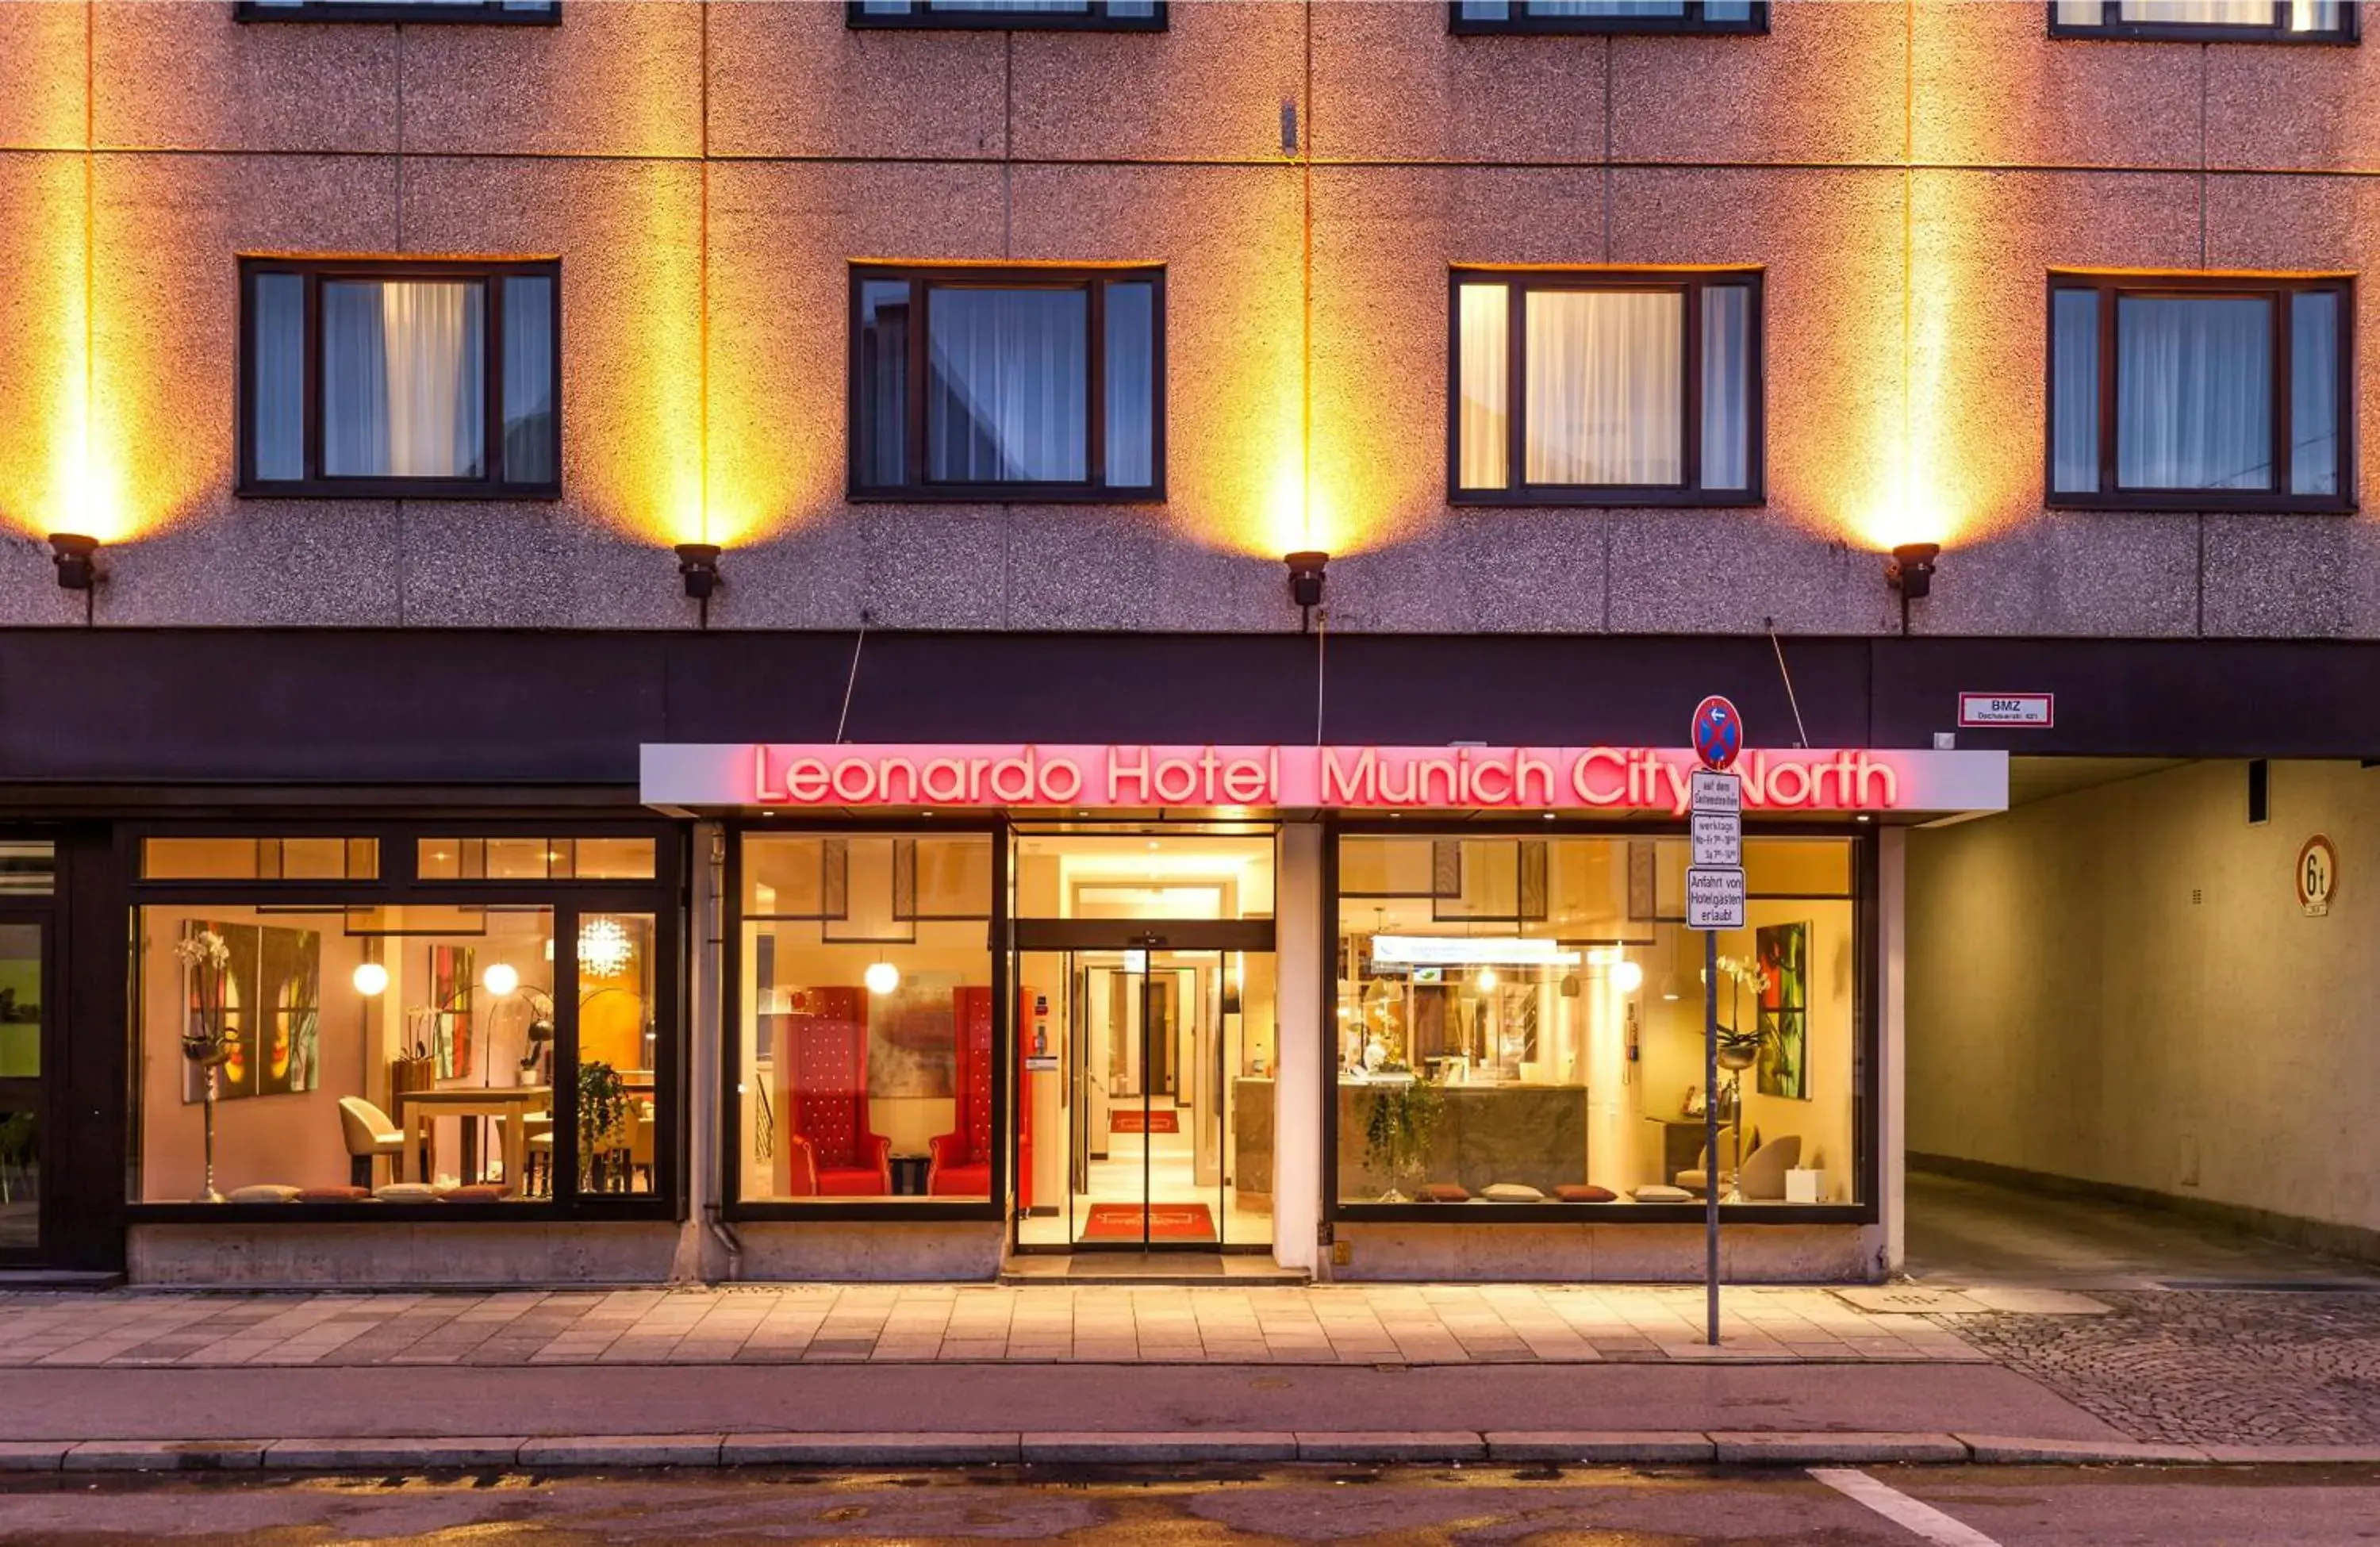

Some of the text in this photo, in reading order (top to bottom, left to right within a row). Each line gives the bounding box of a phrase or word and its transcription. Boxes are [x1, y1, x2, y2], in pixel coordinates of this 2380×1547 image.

[1992, 701, 2021, 712] BMZ
[754, 745, 1898, 816] Leonardo Hotel Munich City North
[1716, 780, 1730, 792] dem
[1699, 820, 1734, 833] werktags
[1691, 875, 1741, 889] Anfahrt von
[1701, 908, 1733, 921] erlaubt
